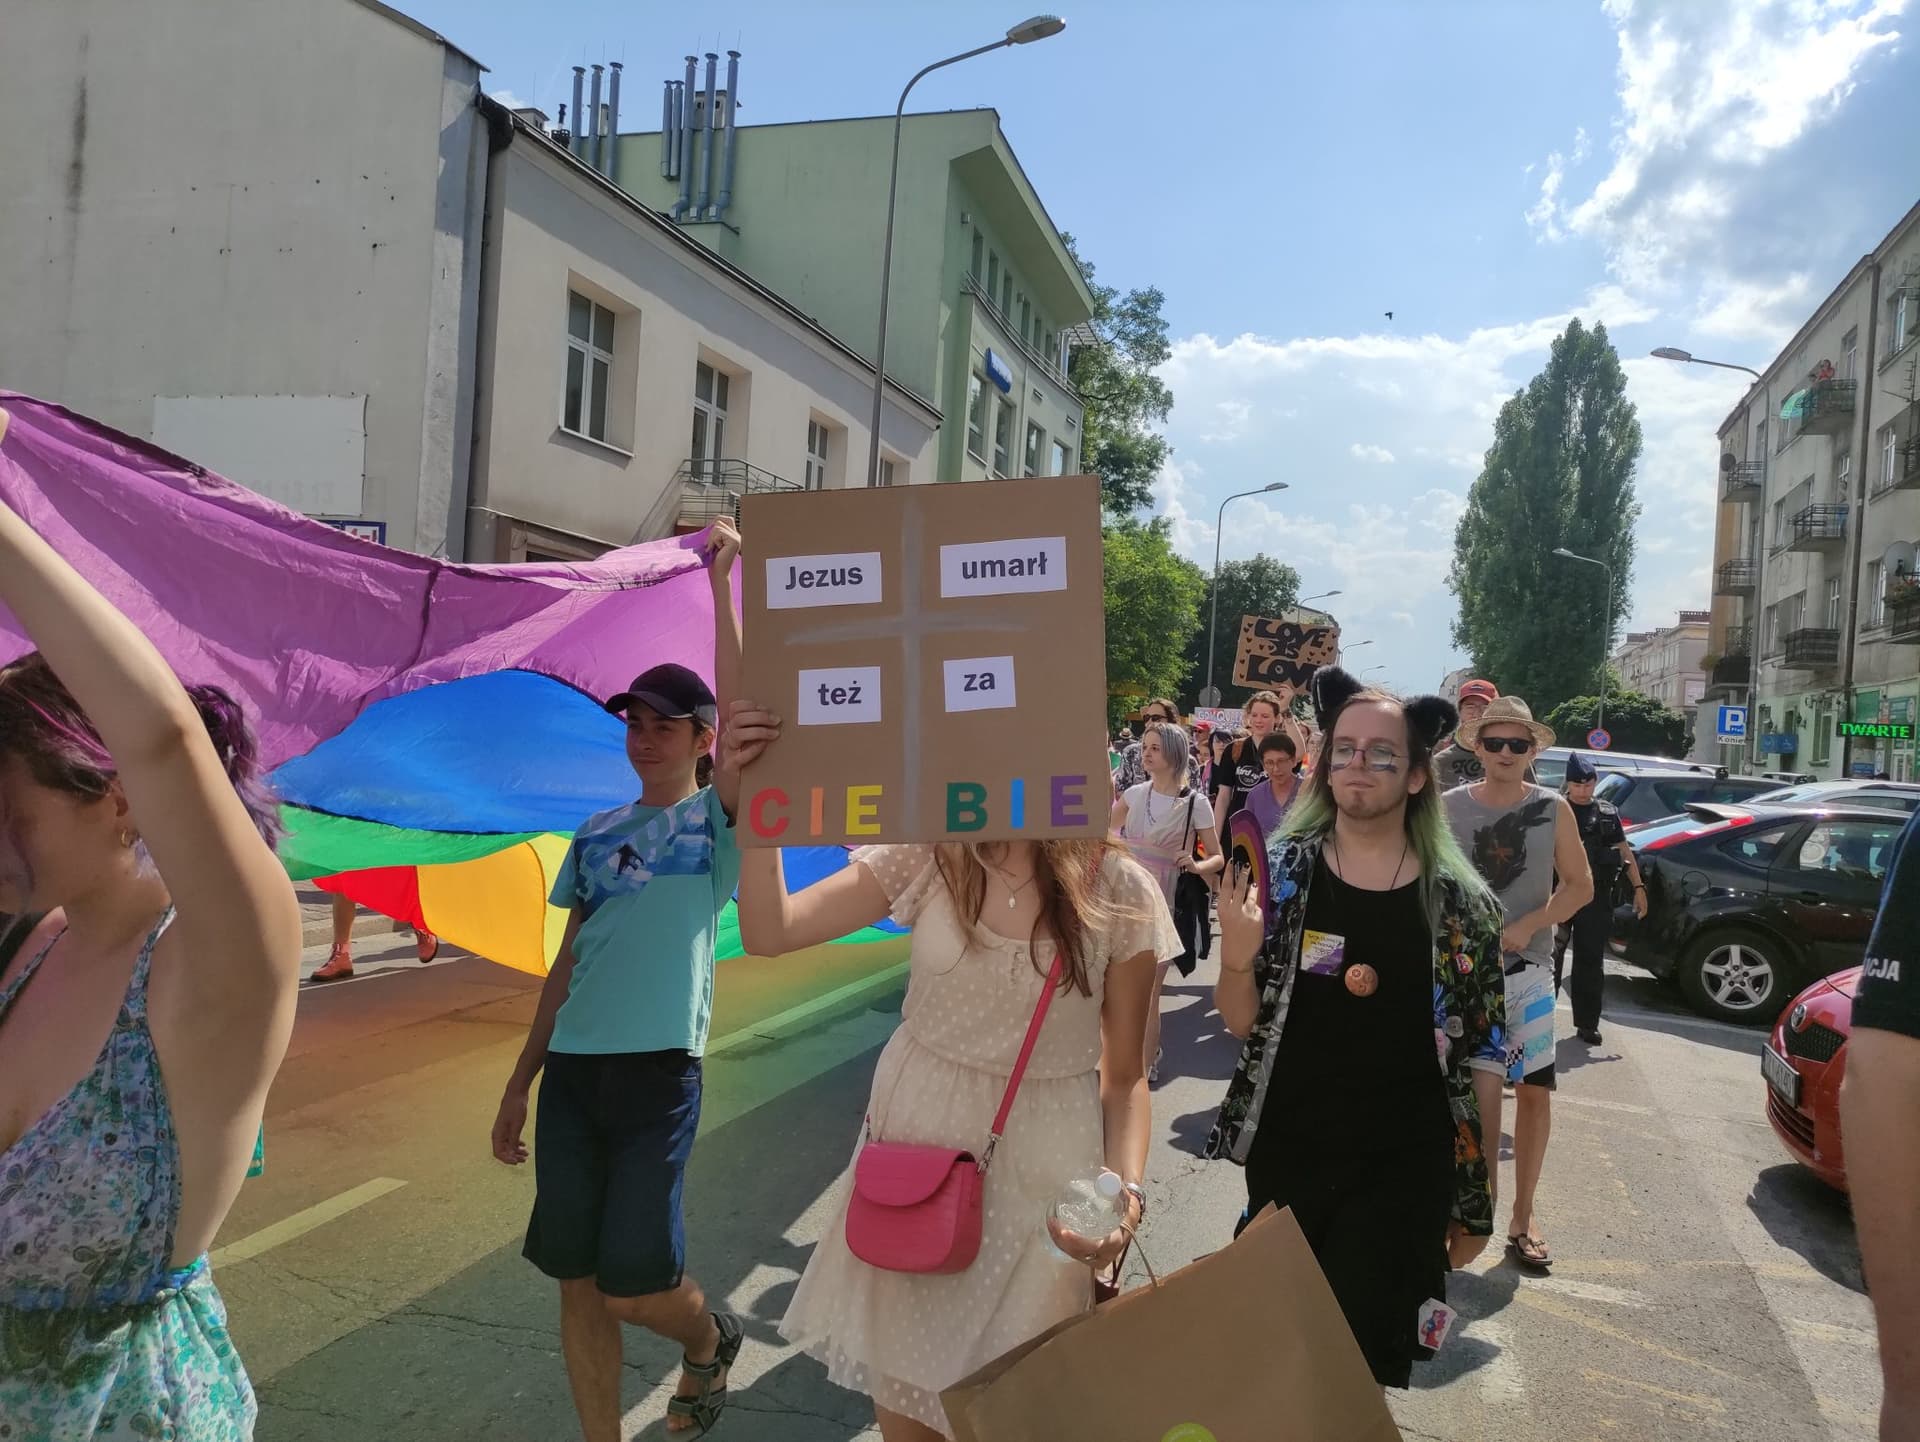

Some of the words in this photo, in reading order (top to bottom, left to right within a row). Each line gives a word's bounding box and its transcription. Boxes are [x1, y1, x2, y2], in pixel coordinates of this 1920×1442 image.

[785, 565, 864, 591] Jezus
[961, 552, 1048, 580] umarł
[1254, 618, 1330, 649] LOVE
[817, 680, 863, 706] też
[963, 671, 996, 692] za
[1718, 735, 1745, 744] Konie
[1839, 722, 1911, 738] TWARTE
